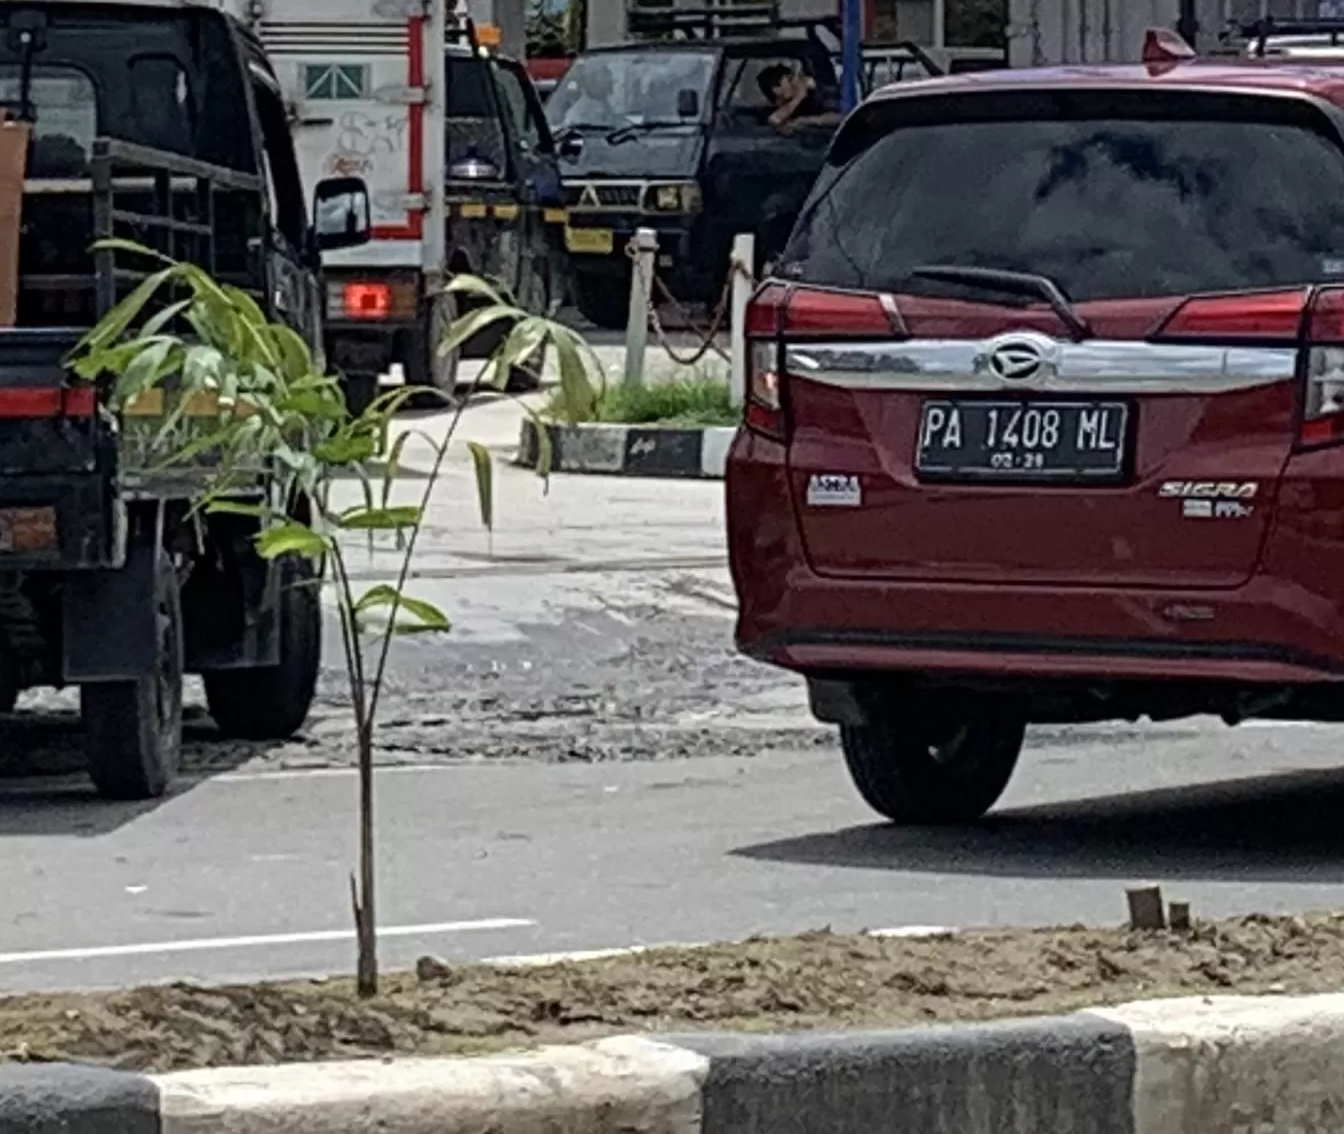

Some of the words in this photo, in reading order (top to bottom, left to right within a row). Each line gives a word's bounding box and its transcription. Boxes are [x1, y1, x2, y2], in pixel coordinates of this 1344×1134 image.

[923, 407, 961, 449] PA
[987, 409, 1060, 449] 1408
[1076, 409, 1116, 450] ML
[1158, 480, 1259, 498] SIGRA
